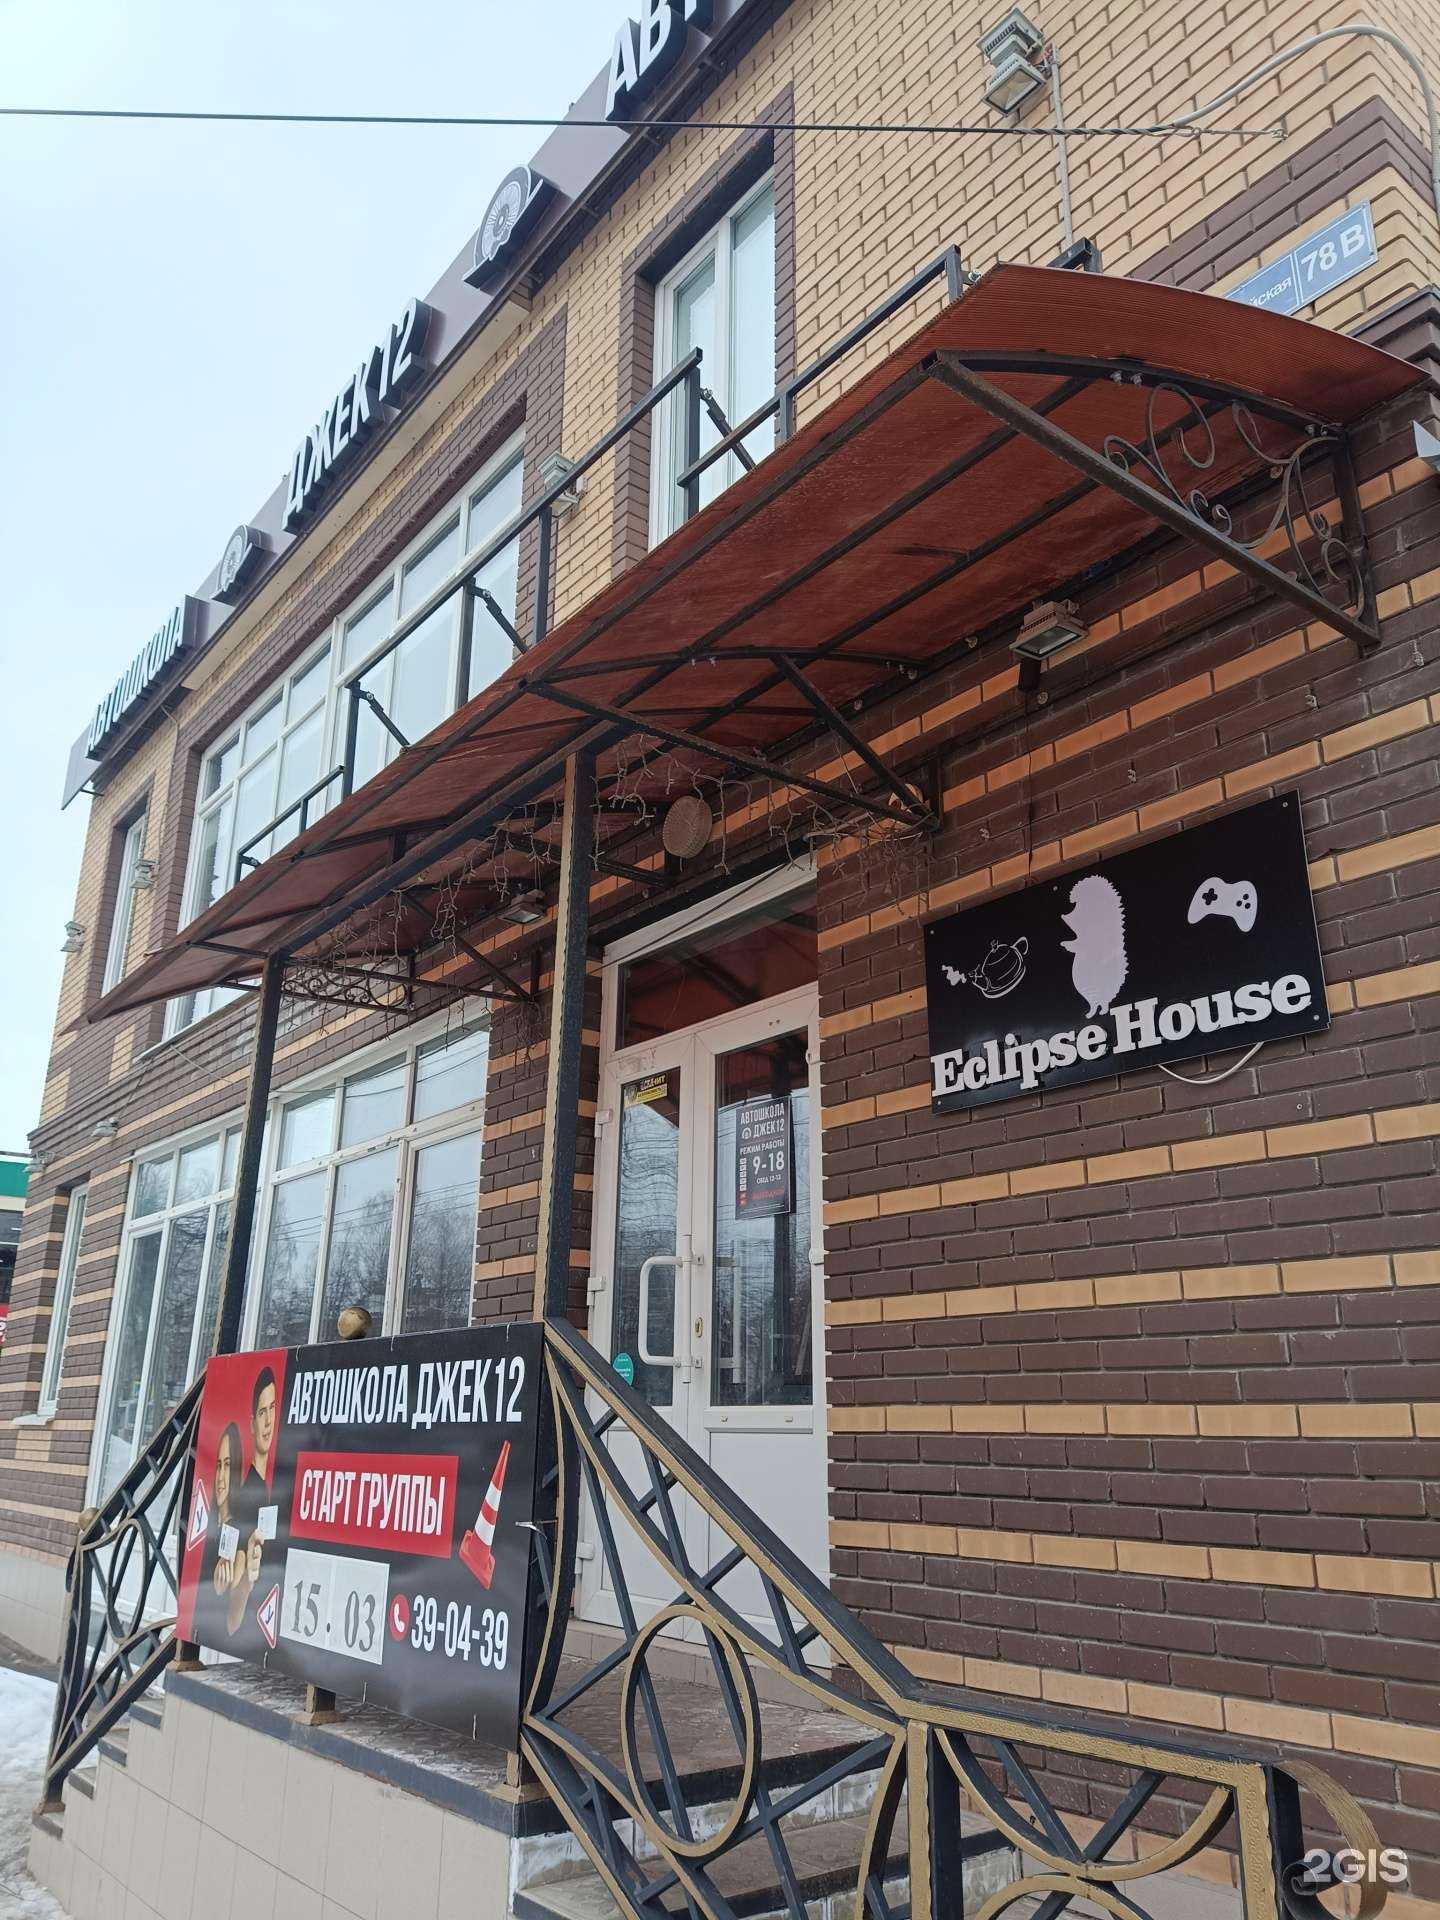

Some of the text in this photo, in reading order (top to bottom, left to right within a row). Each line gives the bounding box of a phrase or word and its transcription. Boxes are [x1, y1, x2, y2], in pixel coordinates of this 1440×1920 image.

[930, 972, 1312, 1098] Eclipse House
[740, 1102, 785, 1125] АВТОШКОЛА
[752, 1150, 785, 1175] 9-18
[761, 1138, 785, 1151] РАБОТЫ
[287, 1364, 409, 1424] АВТОШКОЛА
[299, 1468, 446, 1536] СТАРТ ГРУППЫ
[410, 1594, 510, 1671] 39-04-39
